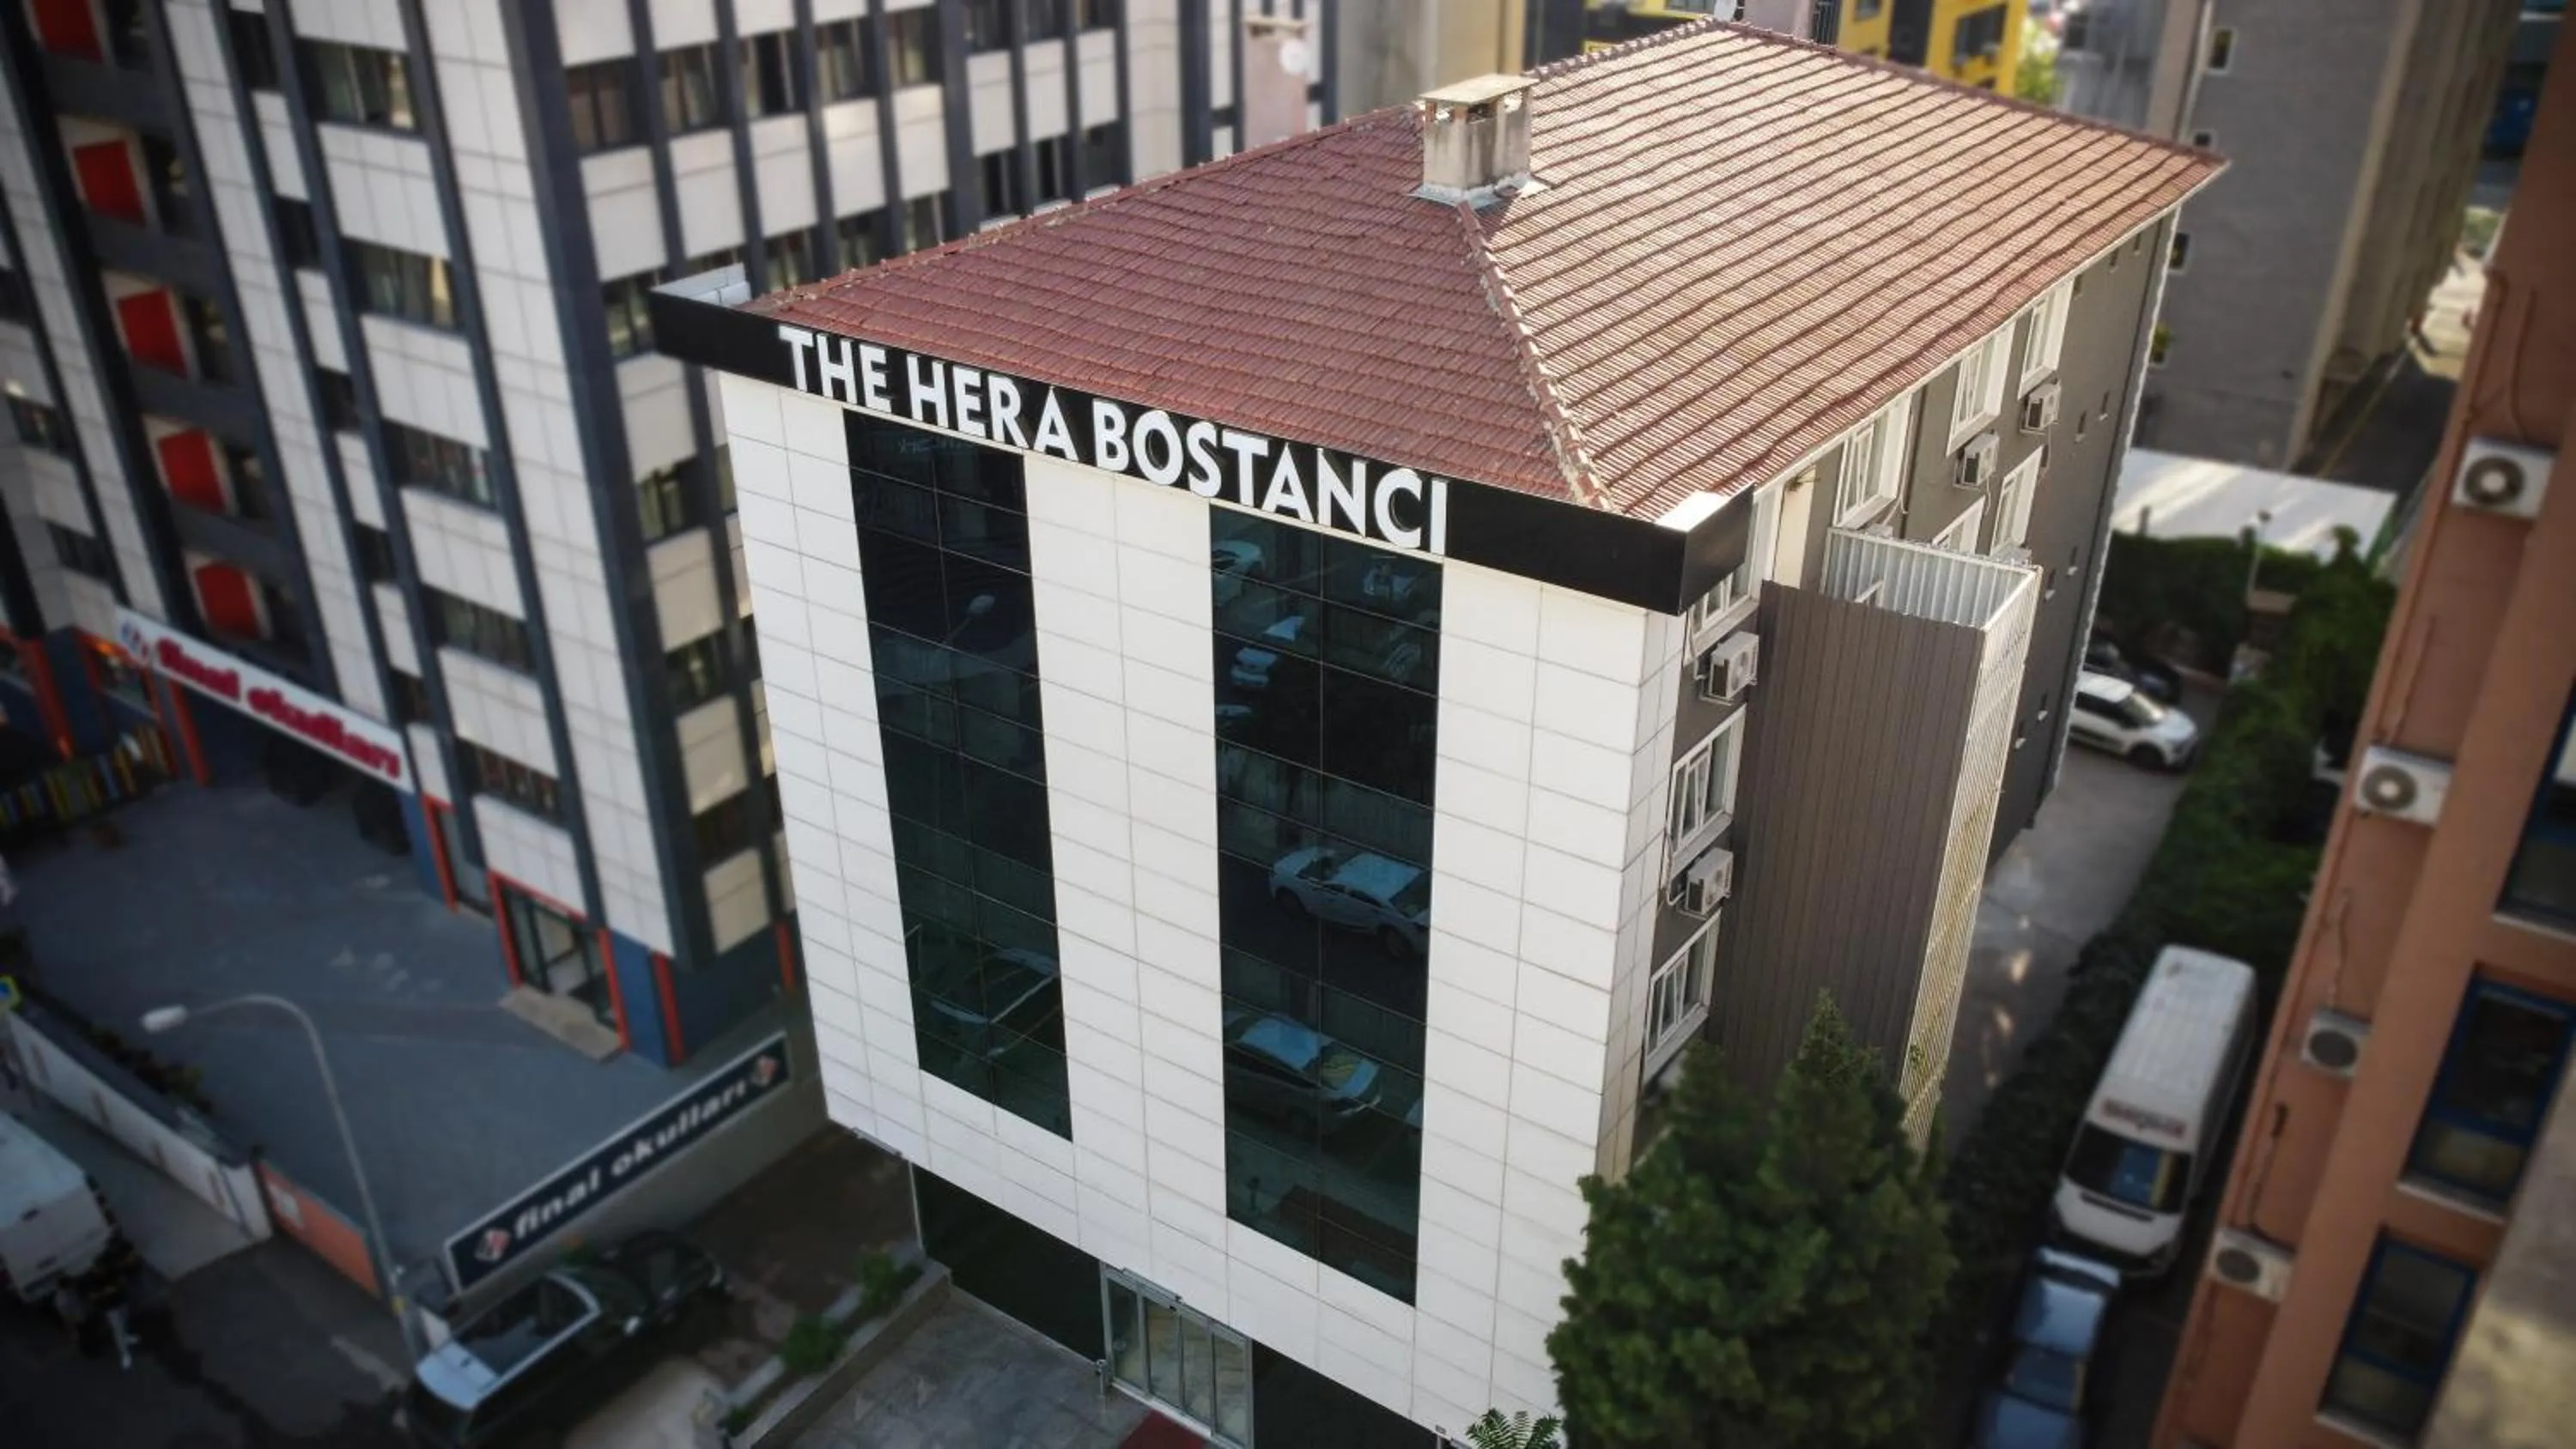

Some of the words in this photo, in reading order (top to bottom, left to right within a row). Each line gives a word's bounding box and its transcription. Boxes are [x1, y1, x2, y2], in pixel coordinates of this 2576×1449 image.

[778, 324, 892, 414] THE
[907, 354, 1079, 463] HERA
[1092, 397, 1449, 555] BOSTANCI
[514, 1167, 599, 1239] final
